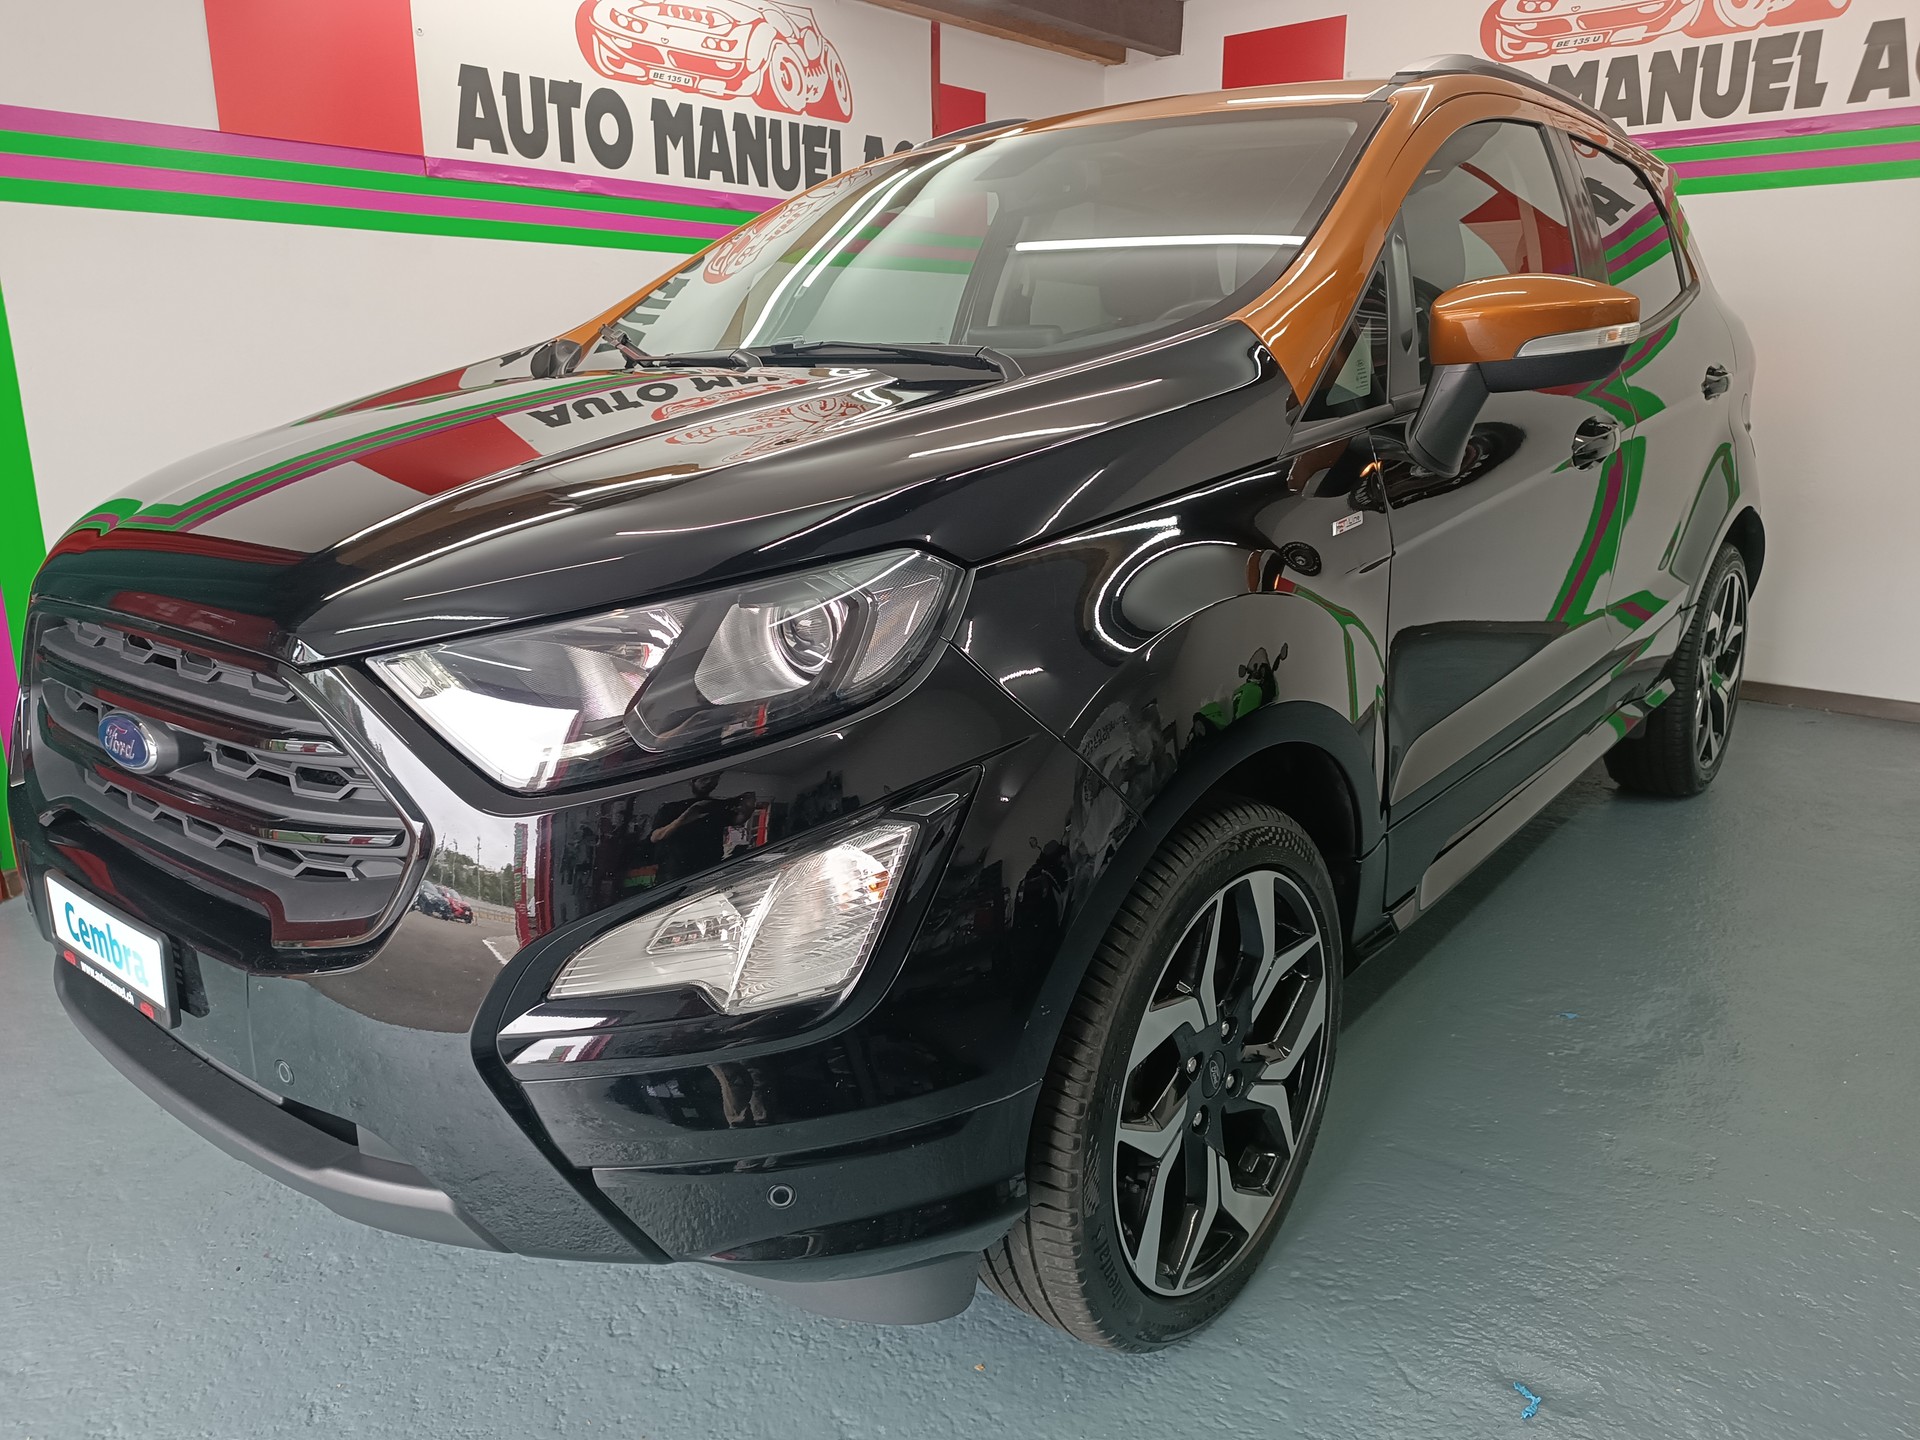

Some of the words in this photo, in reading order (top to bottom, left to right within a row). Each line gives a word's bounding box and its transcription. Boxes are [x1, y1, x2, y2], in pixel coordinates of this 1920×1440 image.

[1547, 29, 1828, 127] MANUEL
[1846, 17, 1920, 104] A
[1573, 37, 1590, 45] 135
[667, 75, 682, 83] 135
[456, 63, 634, 170] AUTO
[103, 721, 136, 759] Ford
[64, 901, 149, 987] Cembra
